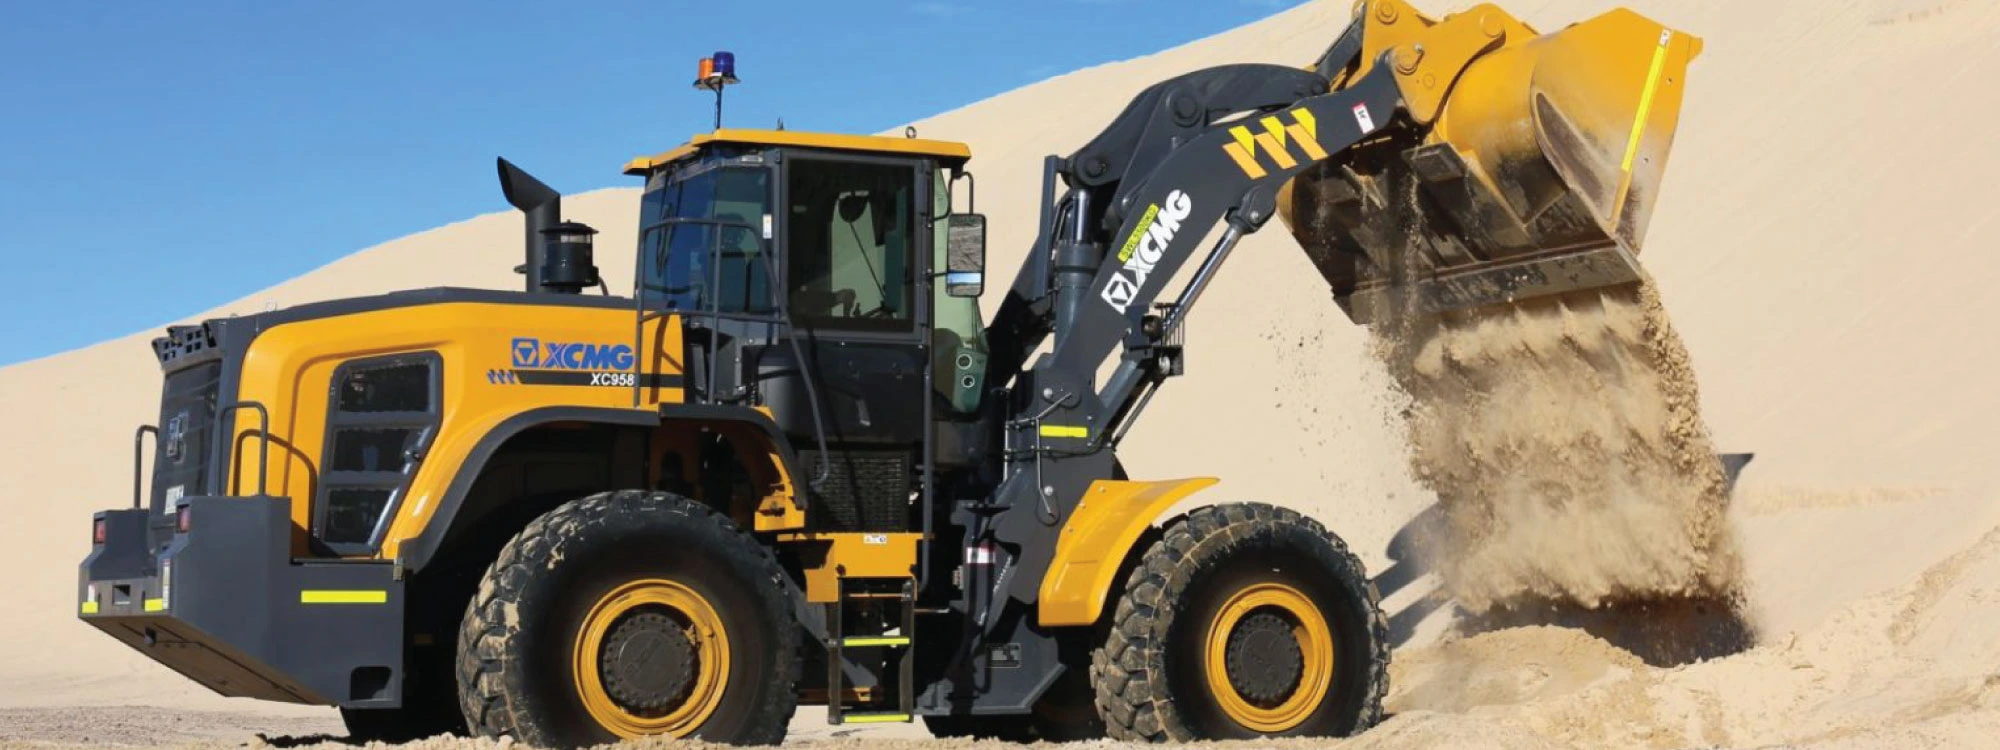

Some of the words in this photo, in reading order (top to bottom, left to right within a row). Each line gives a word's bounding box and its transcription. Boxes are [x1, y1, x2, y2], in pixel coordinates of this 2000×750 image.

[1123, 189, 1191, 289] XCMG
[542, 342, 635, 370] XCMG
[590, 373, 635, 386] XC958
